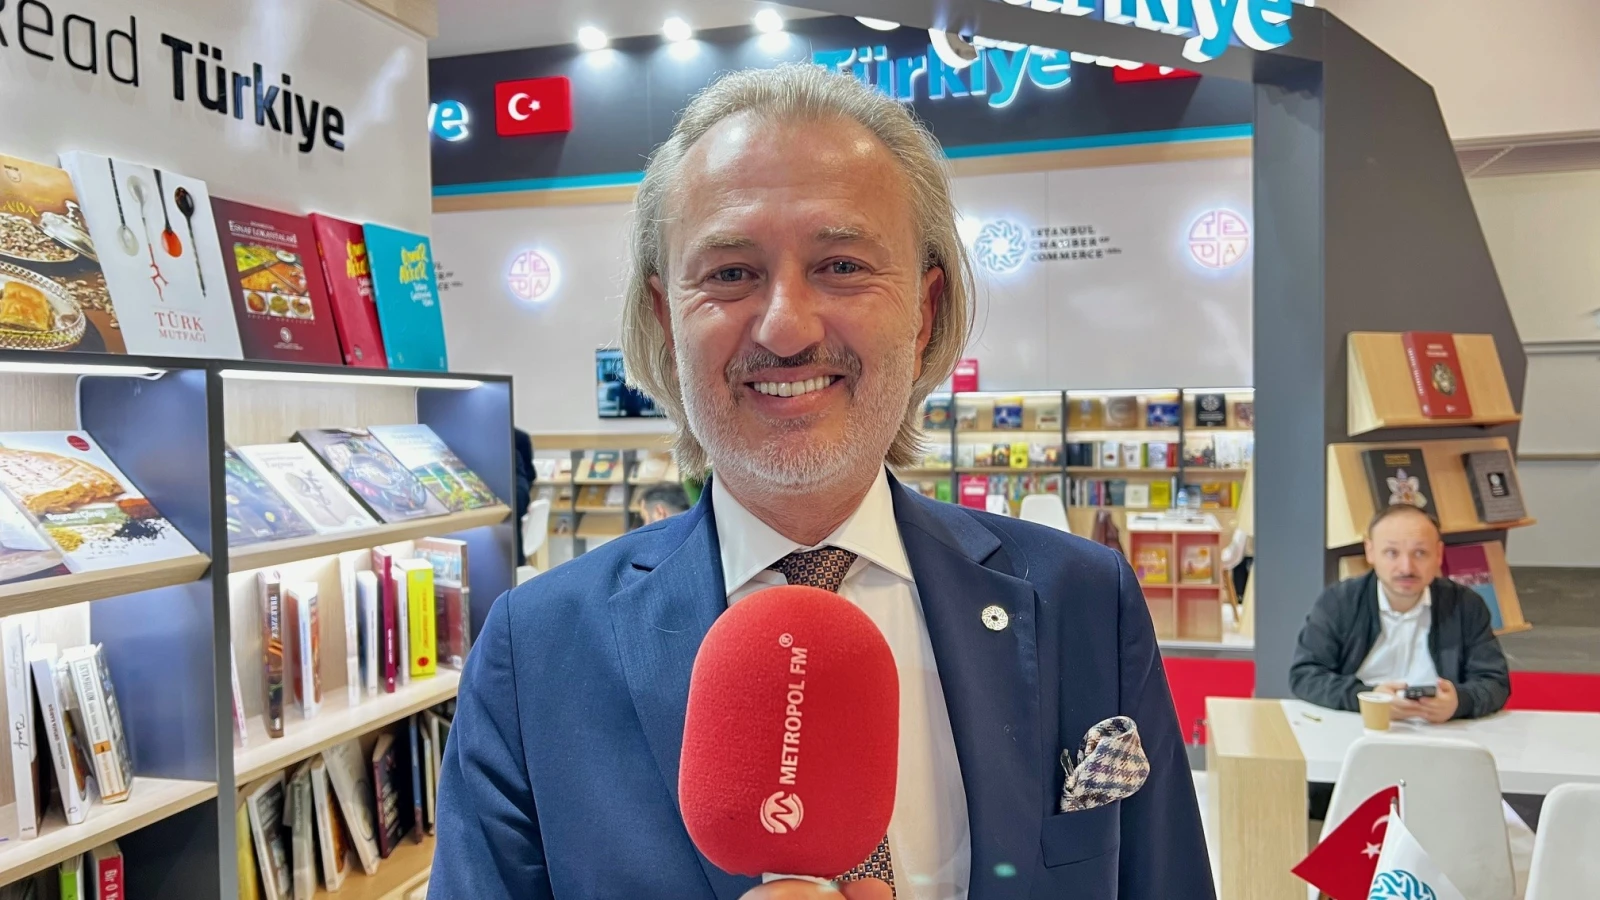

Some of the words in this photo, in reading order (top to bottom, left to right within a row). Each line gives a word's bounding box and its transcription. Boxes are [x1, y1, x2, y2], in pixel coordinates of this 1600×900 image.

[161, 33, 345, 153] Türkiye
[154, 311, 204, 332] TÜRK
[790, 647, 808, 675] FM
[779, 680, 806, 786] METROPOL
